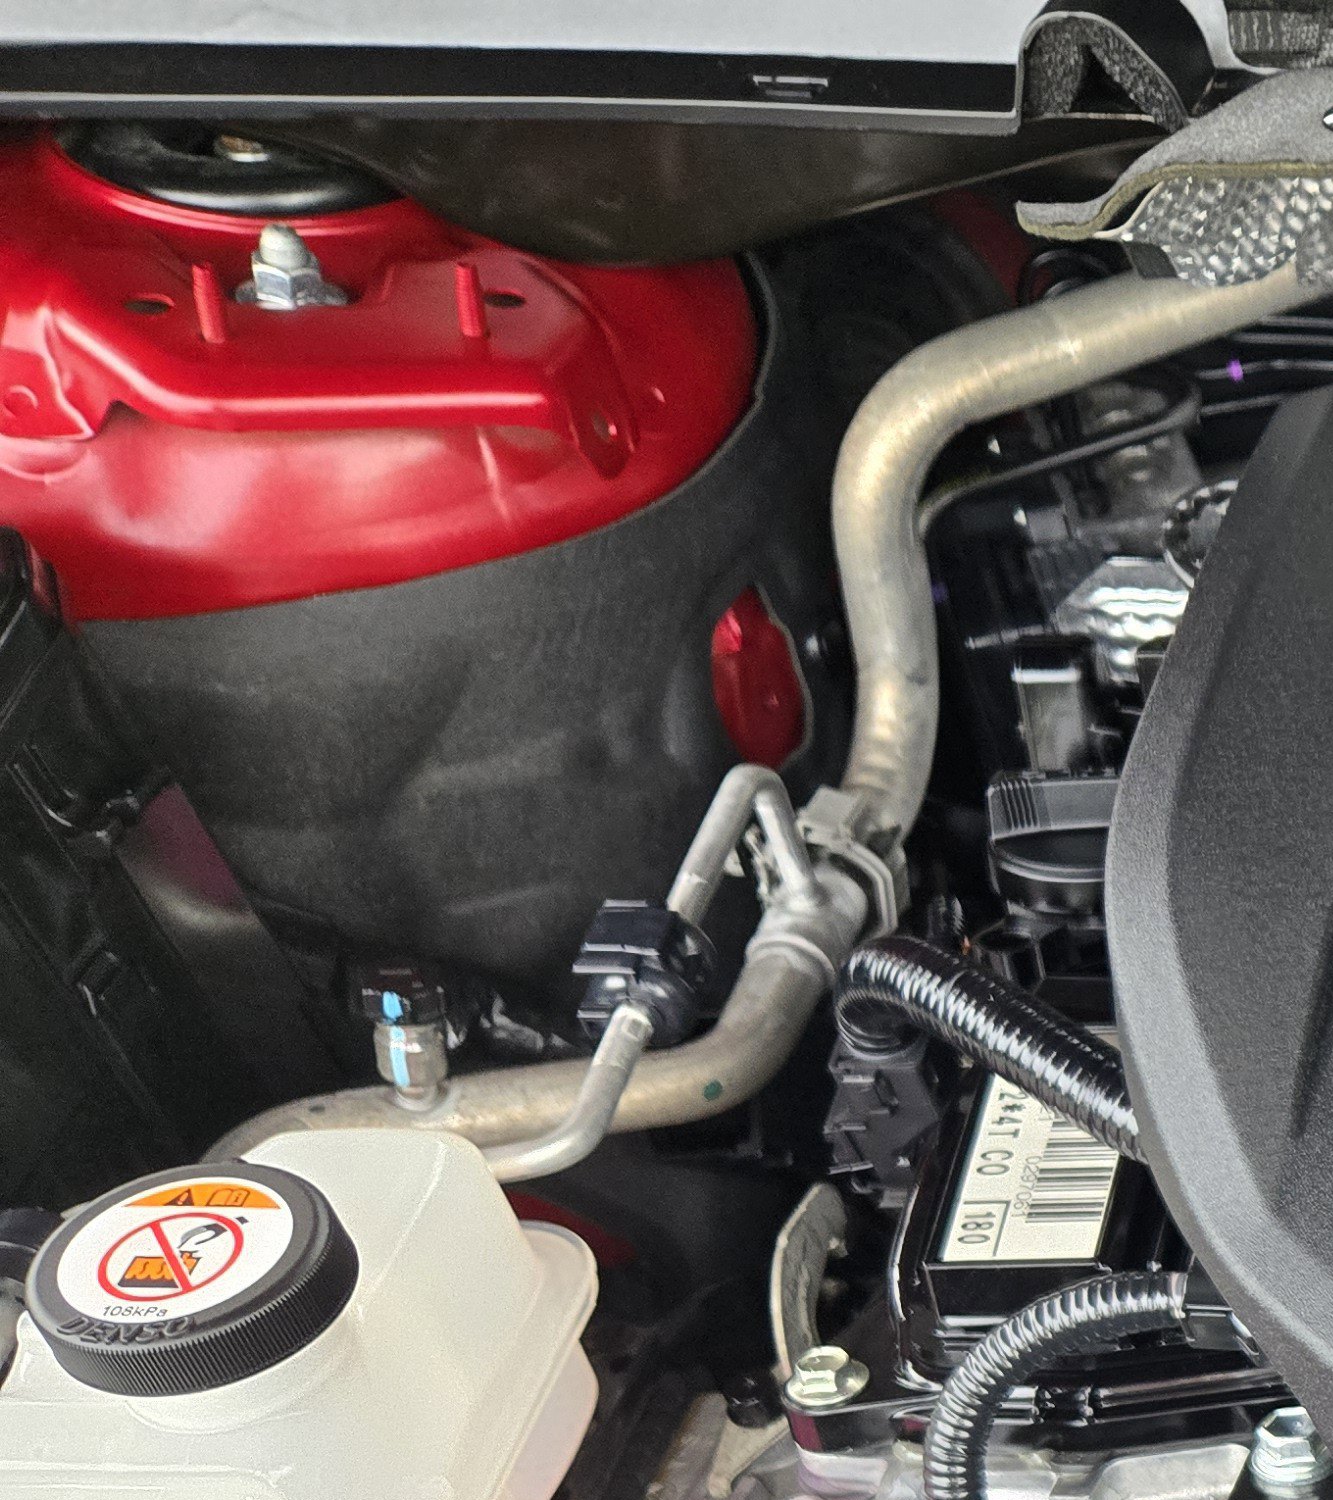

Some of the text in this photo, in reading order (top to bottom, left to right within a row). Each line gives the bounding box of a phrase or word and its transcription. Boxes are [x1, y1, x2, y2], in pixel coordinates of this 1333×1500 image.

[957, 1211, 996, 1244] 180
[102, 1303, 169, 1318] 108kPa
[56, 1314, 197, 1346] DENSO
